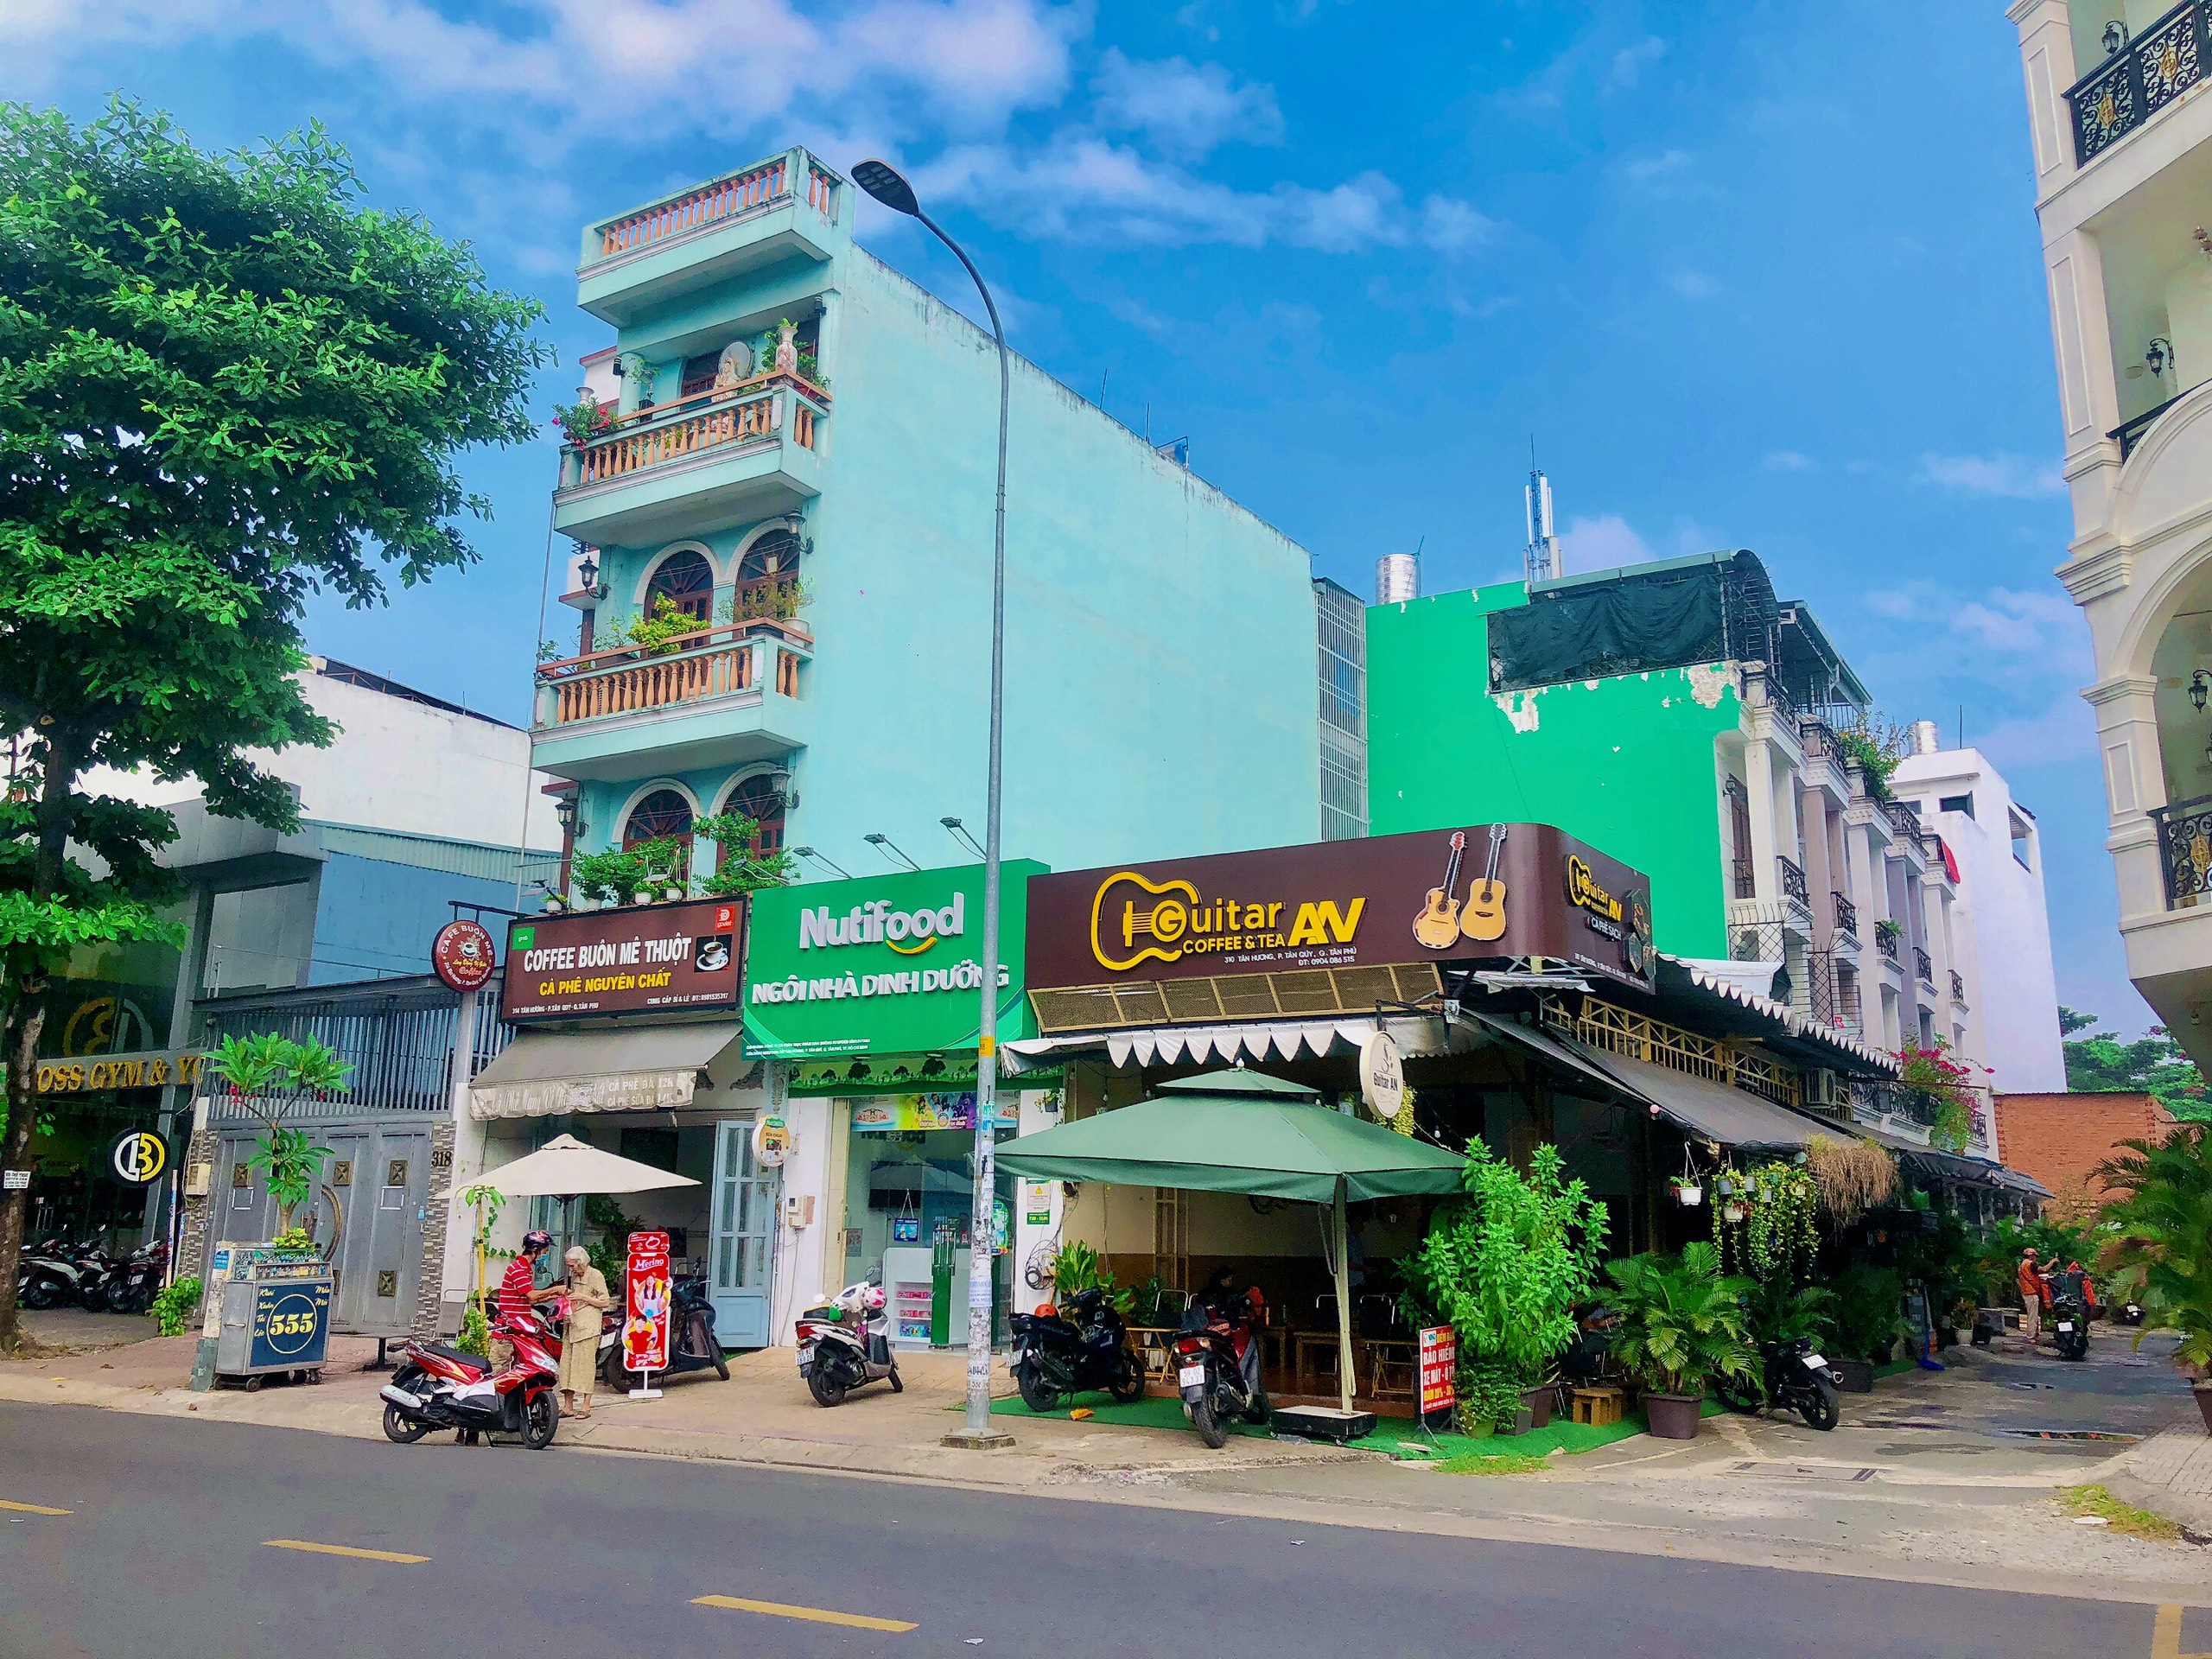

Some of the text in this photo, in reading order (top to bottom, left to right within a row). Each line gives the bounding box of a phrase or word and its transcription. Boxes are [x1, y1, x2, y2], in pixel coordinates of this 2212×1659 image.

[799, 892, 965, 949] Nutifood
[1151, 897, 1367, 947] Guitar AV
[441, 927, 460, 954] CAFE
[524, 931, 692, 972] COFFEE BUÔN MÊ THUỘT
[1182, 933, 1286, 955] COFFEE & TEA
[1237, 953, 1250, 963] TÂN
[1285, 950, 1297, 959] TÂN
[1329, 947, 1342, 956] TÂN
[539, 966, 672, 996] CÀ PHÊ NGUYÊN CHẤT
[752, 974, 808, 1004] NGÔI
[809, 970, 861, 1001] NHÀ
[861, 970, 920, 997] DINH
[37, 1063, 84, 1093] OSS
[90, 1059, 145, 1090] GYM
[149, 1056, 167, 1086] &
[622, 1077, 639, 1091] PHÊ
[432, 1150, 452, 1166] 318
[634, 1257, 664, 1270] Merino
[270, 1312, 315, 1336] 555
[1423, 1346, 1437, 1365] BẢO
[1423, 1370, 1430, 1387] XE
[1430, 1365, 1441, 1385] MÁY
